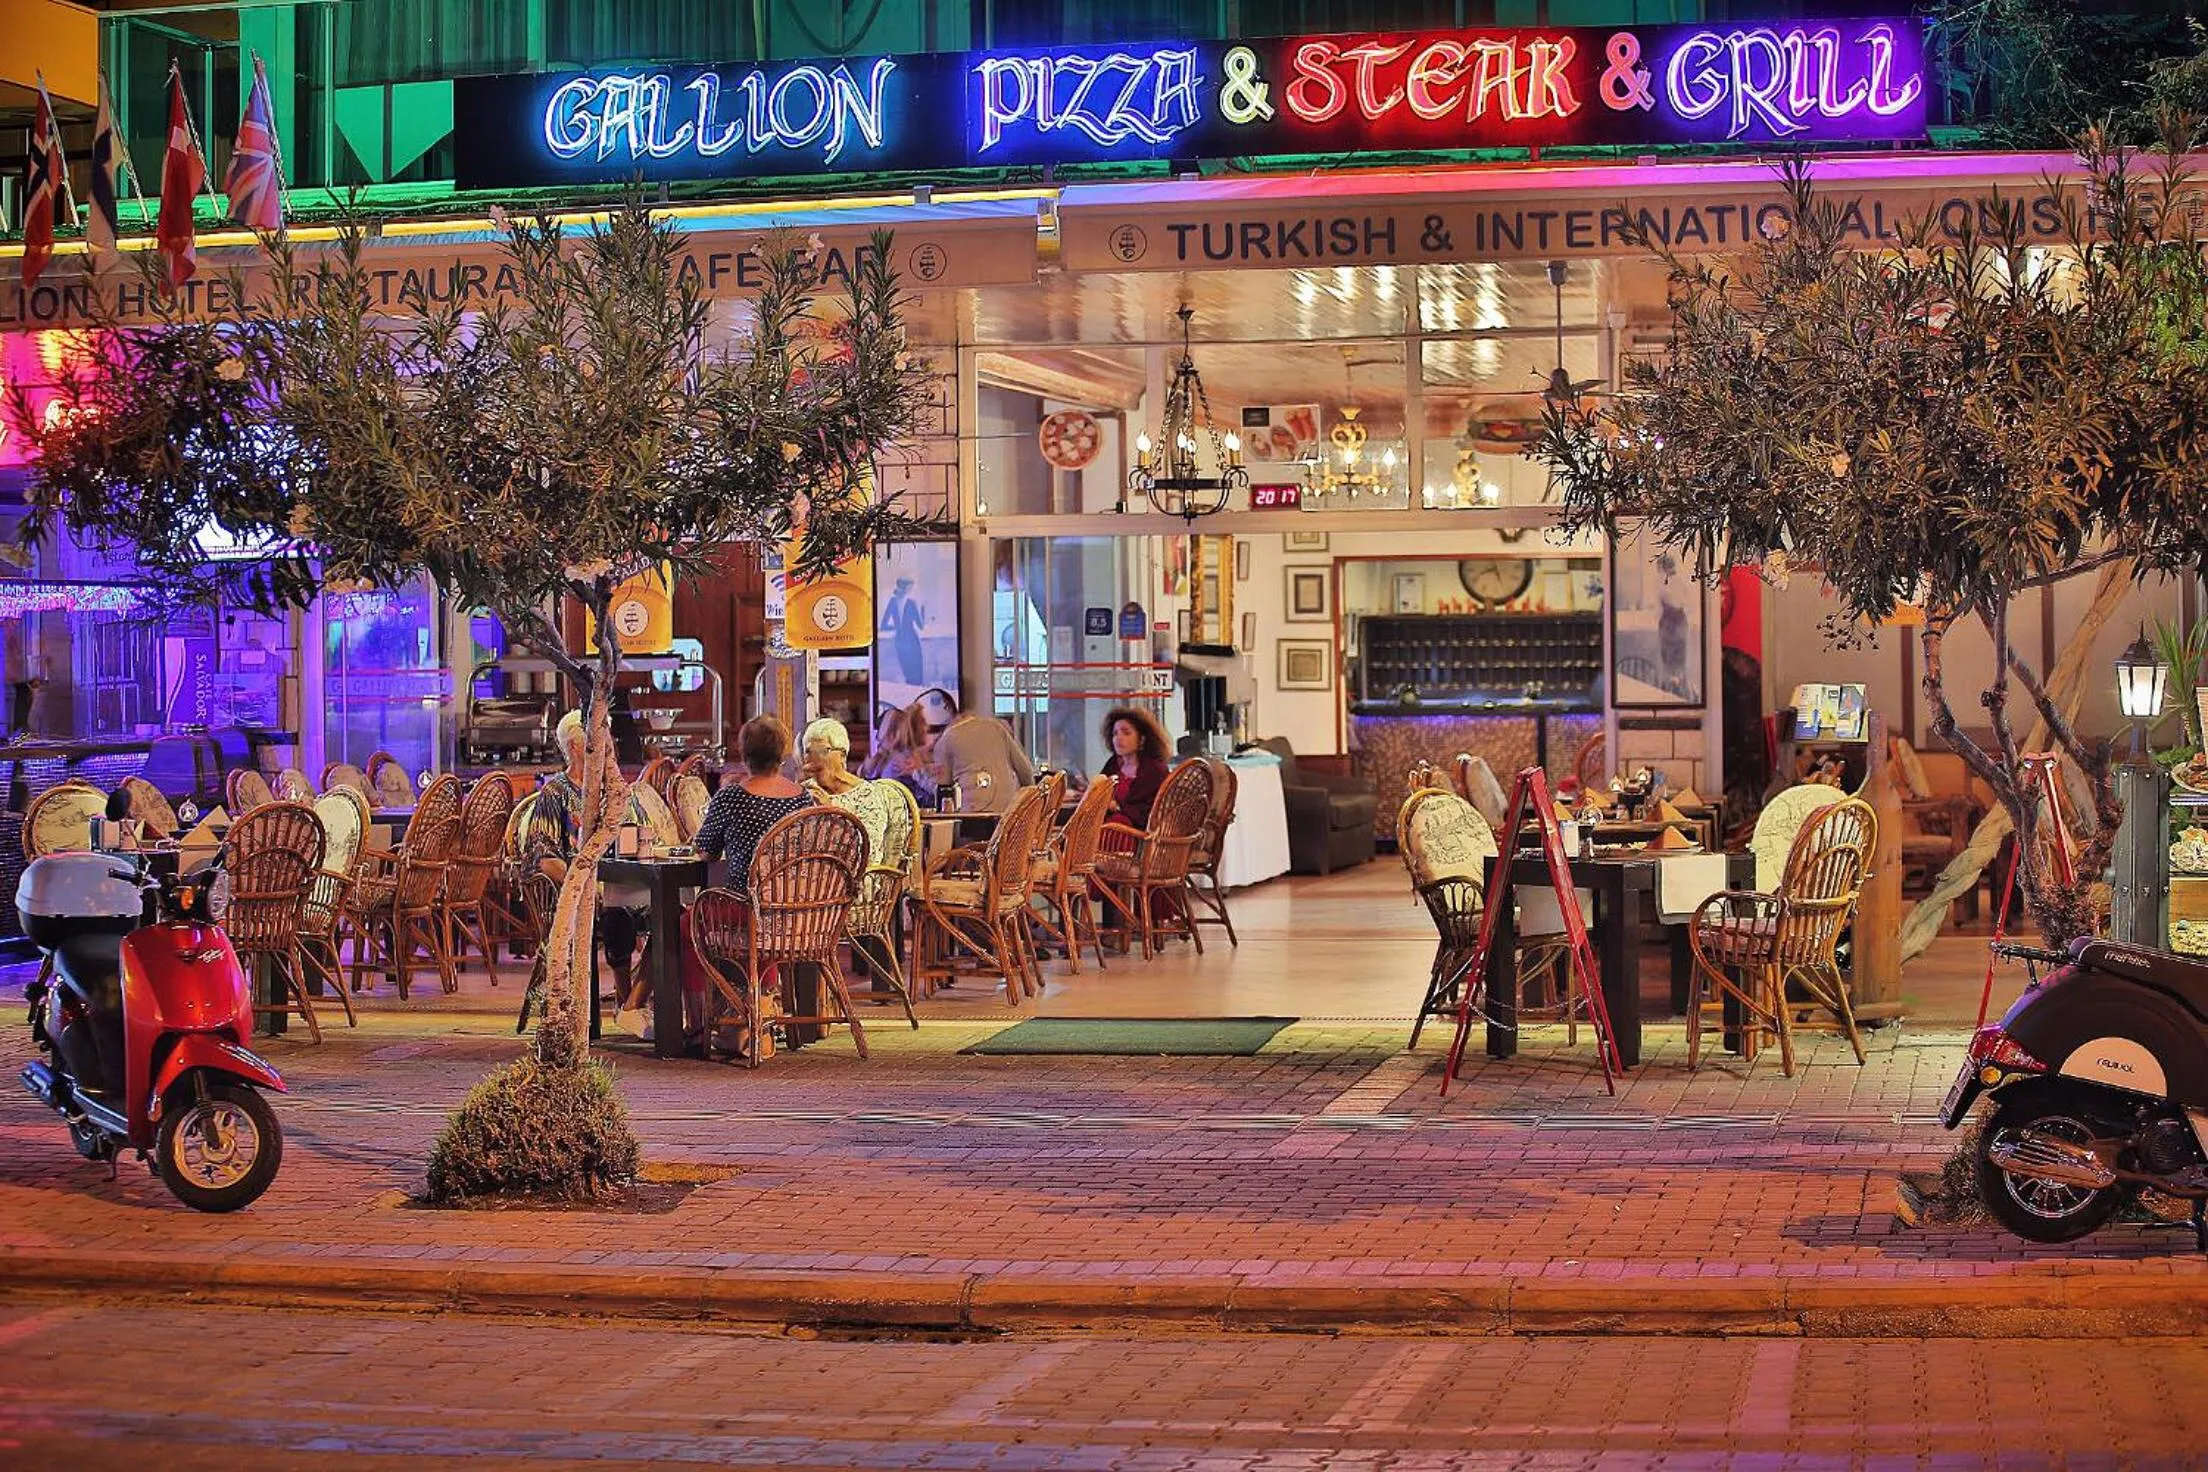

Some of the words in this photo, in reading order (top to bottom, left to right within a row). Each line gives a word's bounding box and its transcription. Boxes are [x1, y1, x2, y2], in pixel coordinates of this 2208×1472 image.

[545, 59, 897, 164] GALLION
[971, 47, 1204, 152] PIZZA
[1219, 46, 1275, 124] &
[1286, 36, 1582, 123] STEAK
[1600, 32, 1655, 111] &
[1667, 24, 1922, 139] GRILL
[1166, 217, 1397, 261] TURKISH
[1419, 214, 1454, 253] &
[1476, 200, 1899, 252] INTERNATIOAL
[195, 653, 207, 719] SALVADOR
